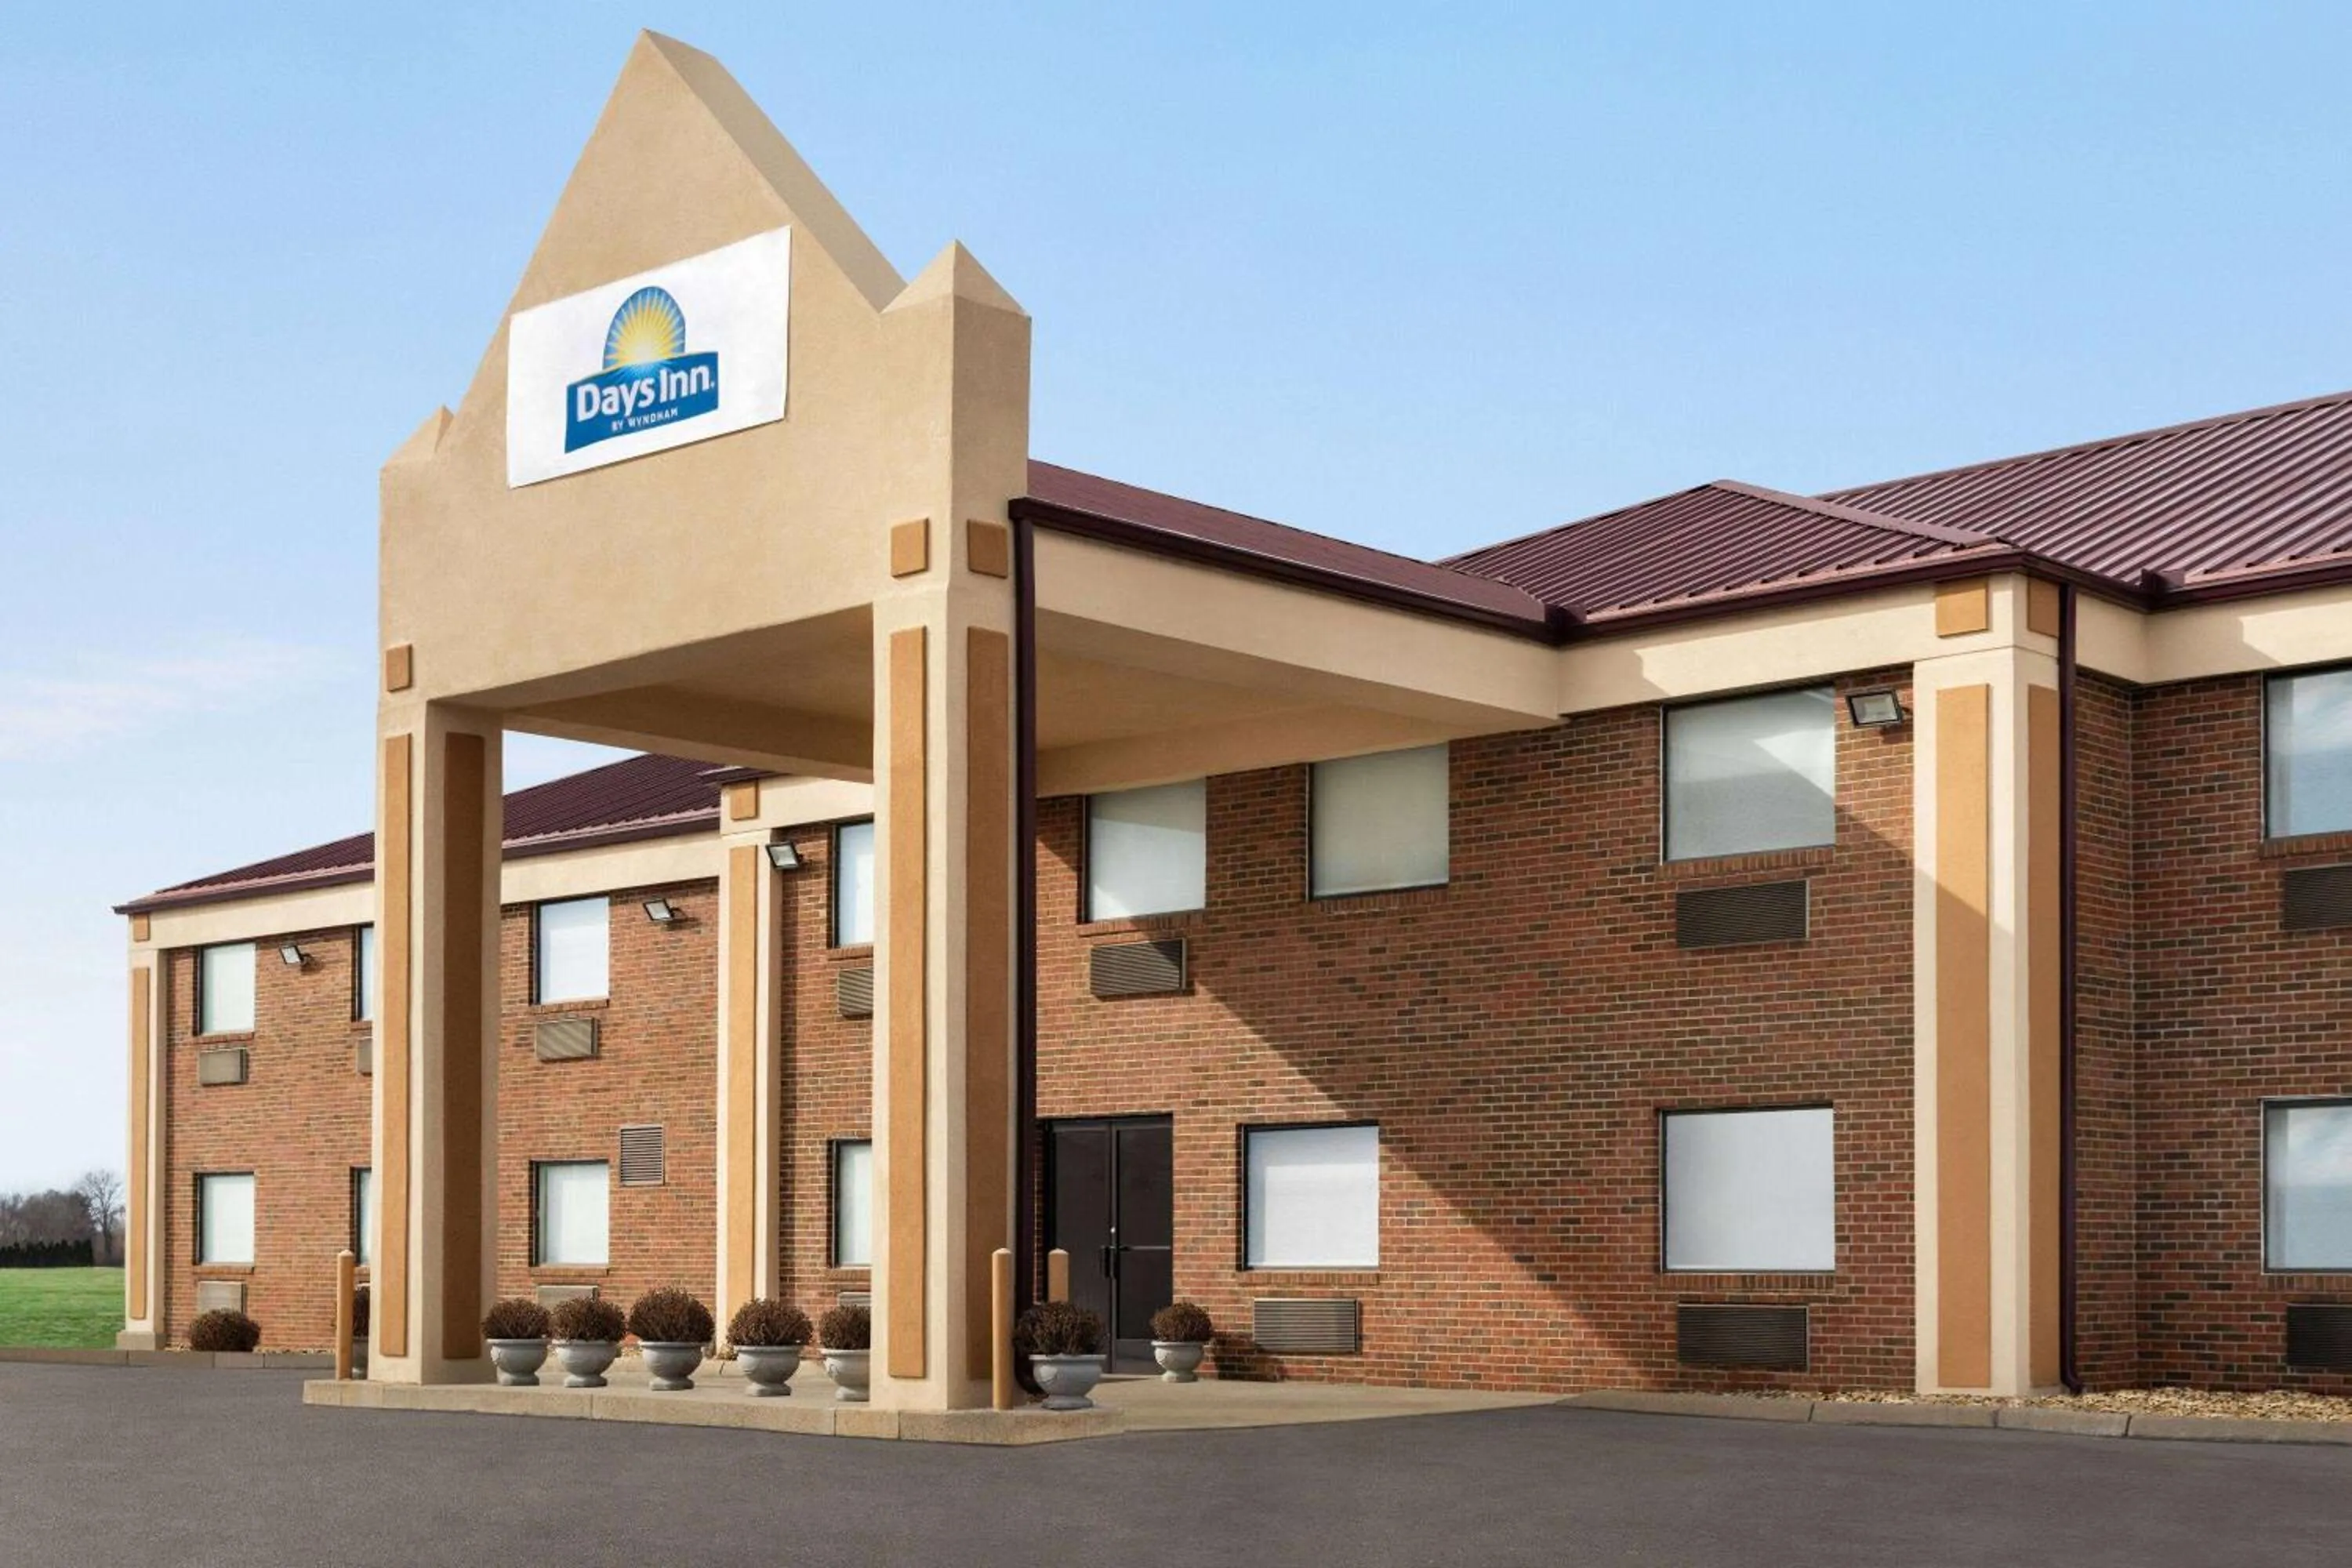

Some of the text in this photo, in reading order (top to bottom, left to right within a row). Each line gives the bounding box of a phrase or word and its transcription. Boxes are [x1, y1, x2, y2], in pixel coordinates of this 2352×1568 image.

[576, 377, 655, 423] Days
[611, 408, 678, 432] BY WYNDHAM
